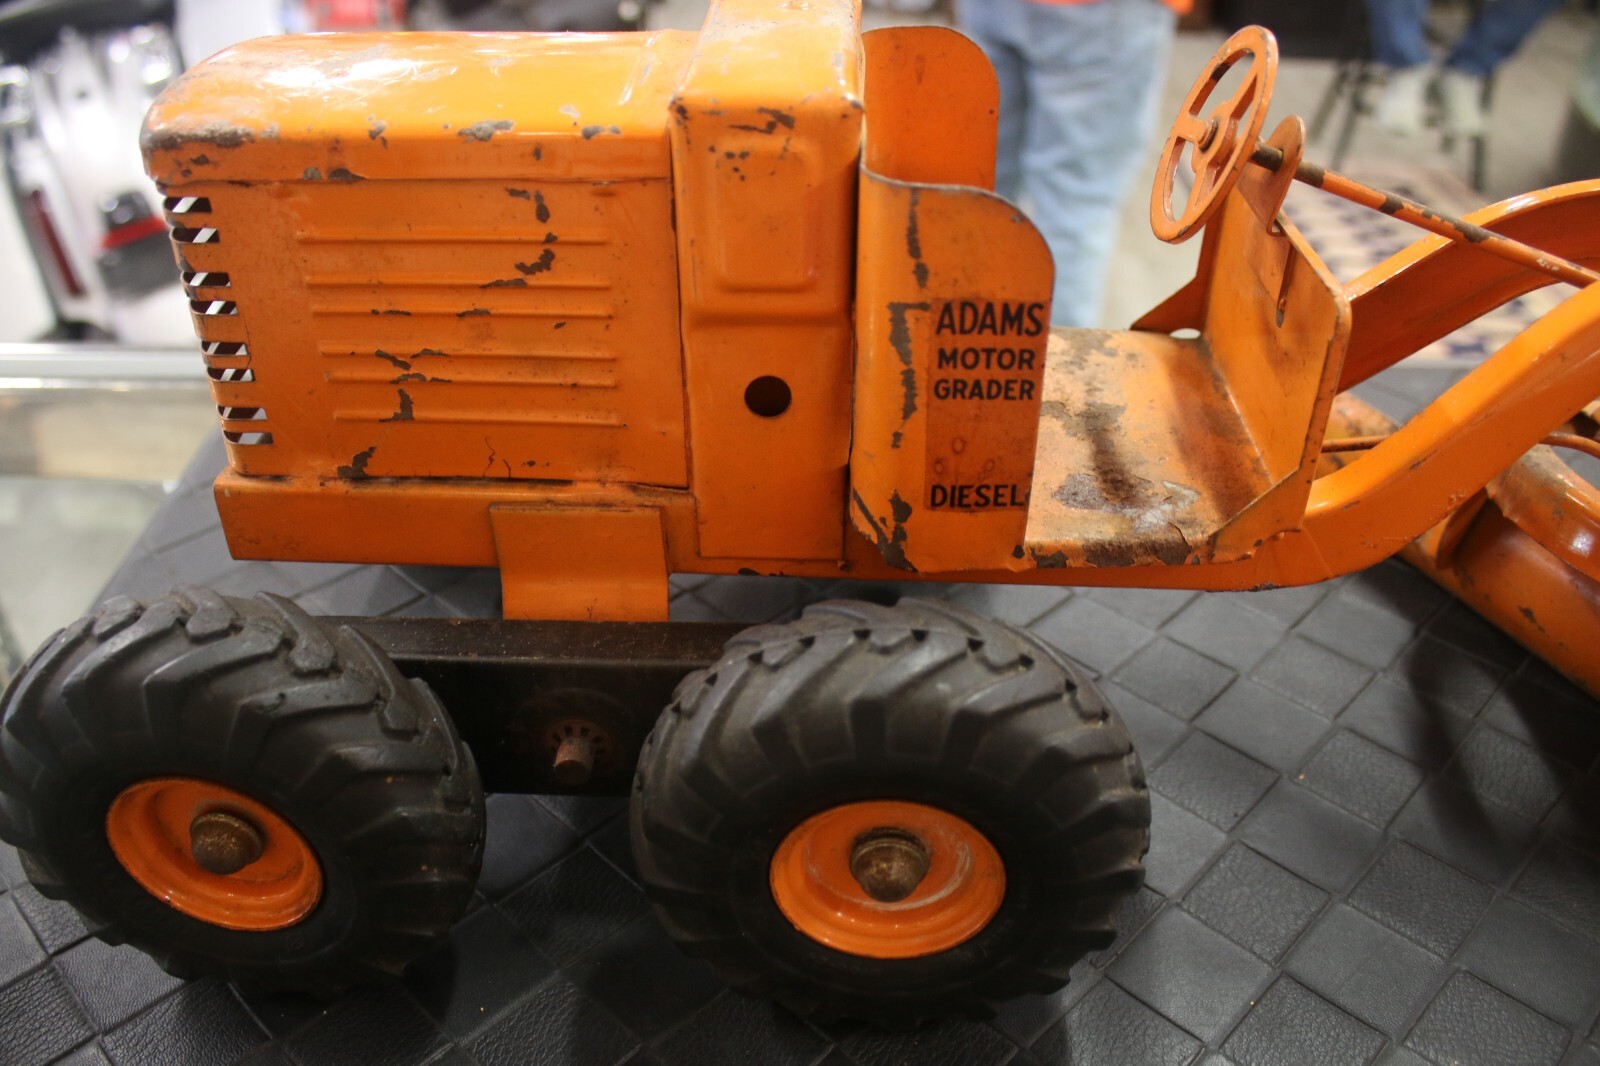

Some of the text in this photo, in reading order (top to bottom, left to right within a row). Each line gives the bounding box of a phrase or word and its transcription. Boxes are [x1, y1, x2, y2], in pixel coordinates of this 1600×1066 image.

[936, 302, 1044, 336] ADAMS
[937, 348, 1036, 370] MOTOR
[934, 379, 1035, 400] GRADER
[930, 484, 1025, 508] DIESEL
